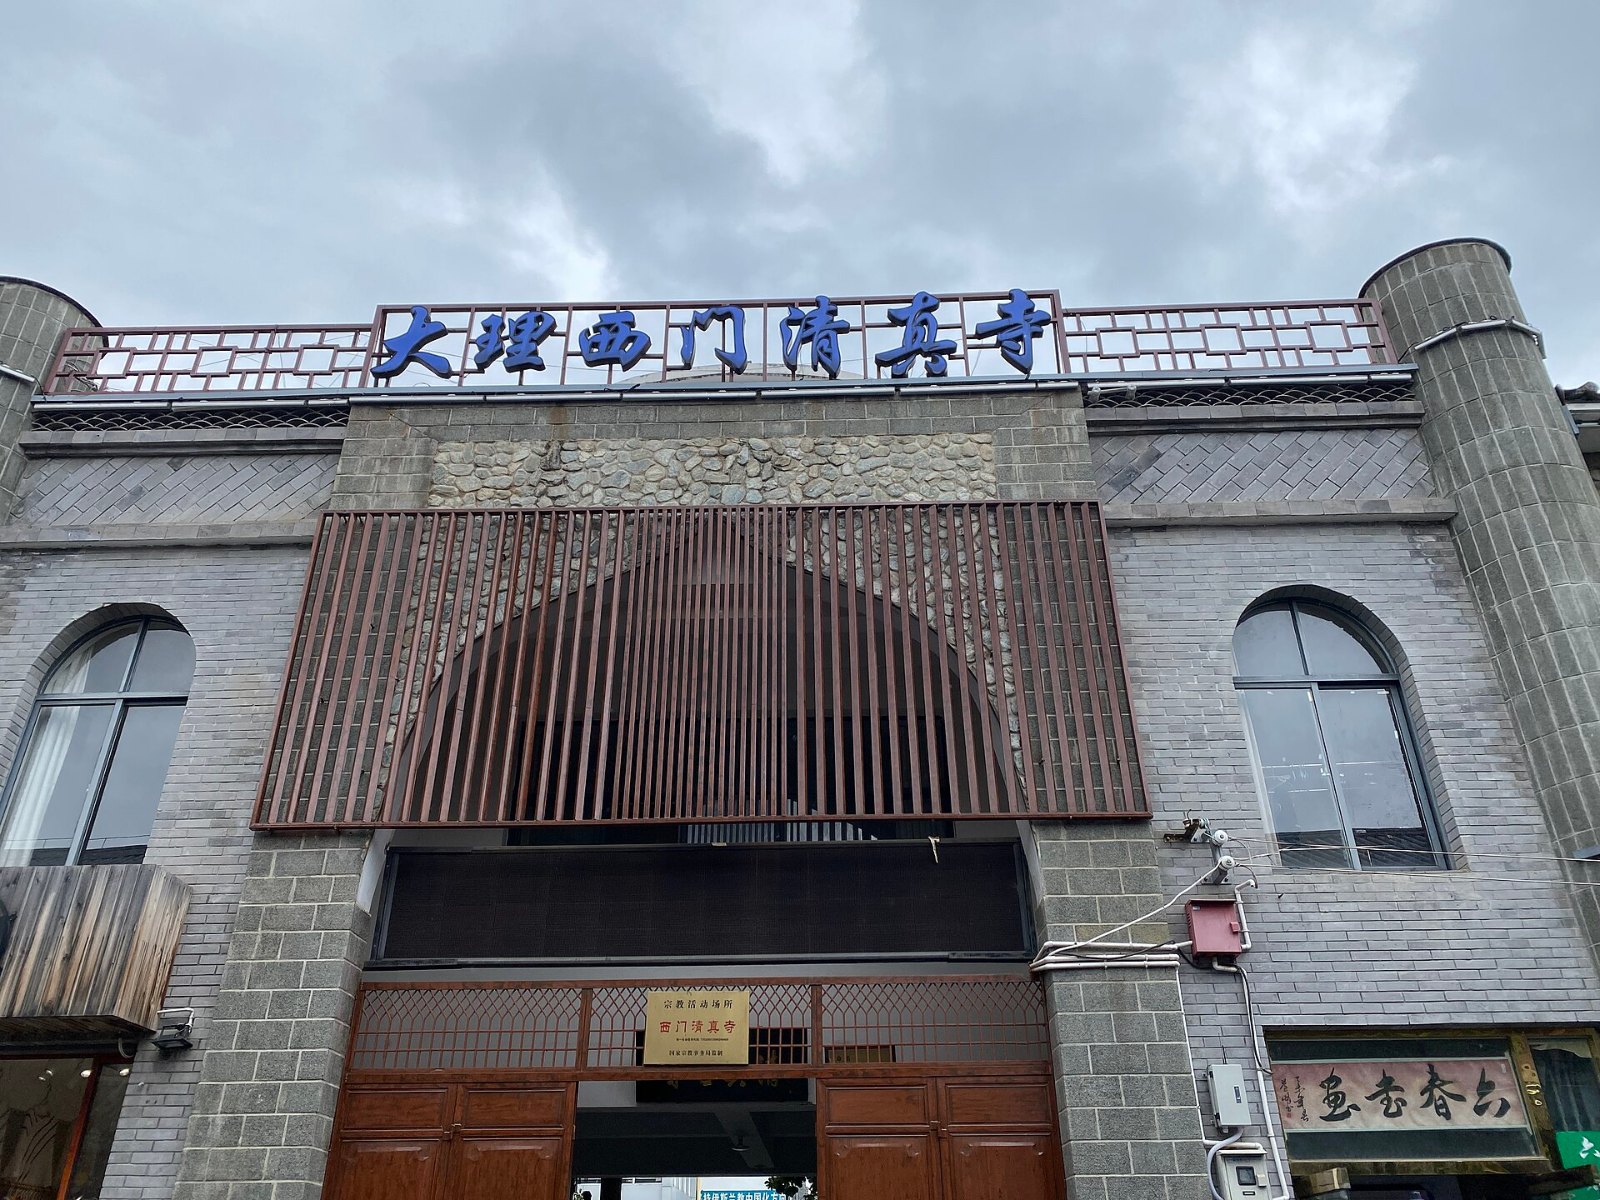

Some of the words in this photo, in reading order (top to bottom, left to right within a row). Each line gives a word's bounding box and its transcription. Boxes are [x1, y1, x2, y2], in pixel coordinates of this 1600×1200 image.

[371, 288, 1052, 379] 大理西门清真寺
[664, 999, 733, 1010] 宗教活动场所
[660, 1020, 736, 1034] 西门清真寺
